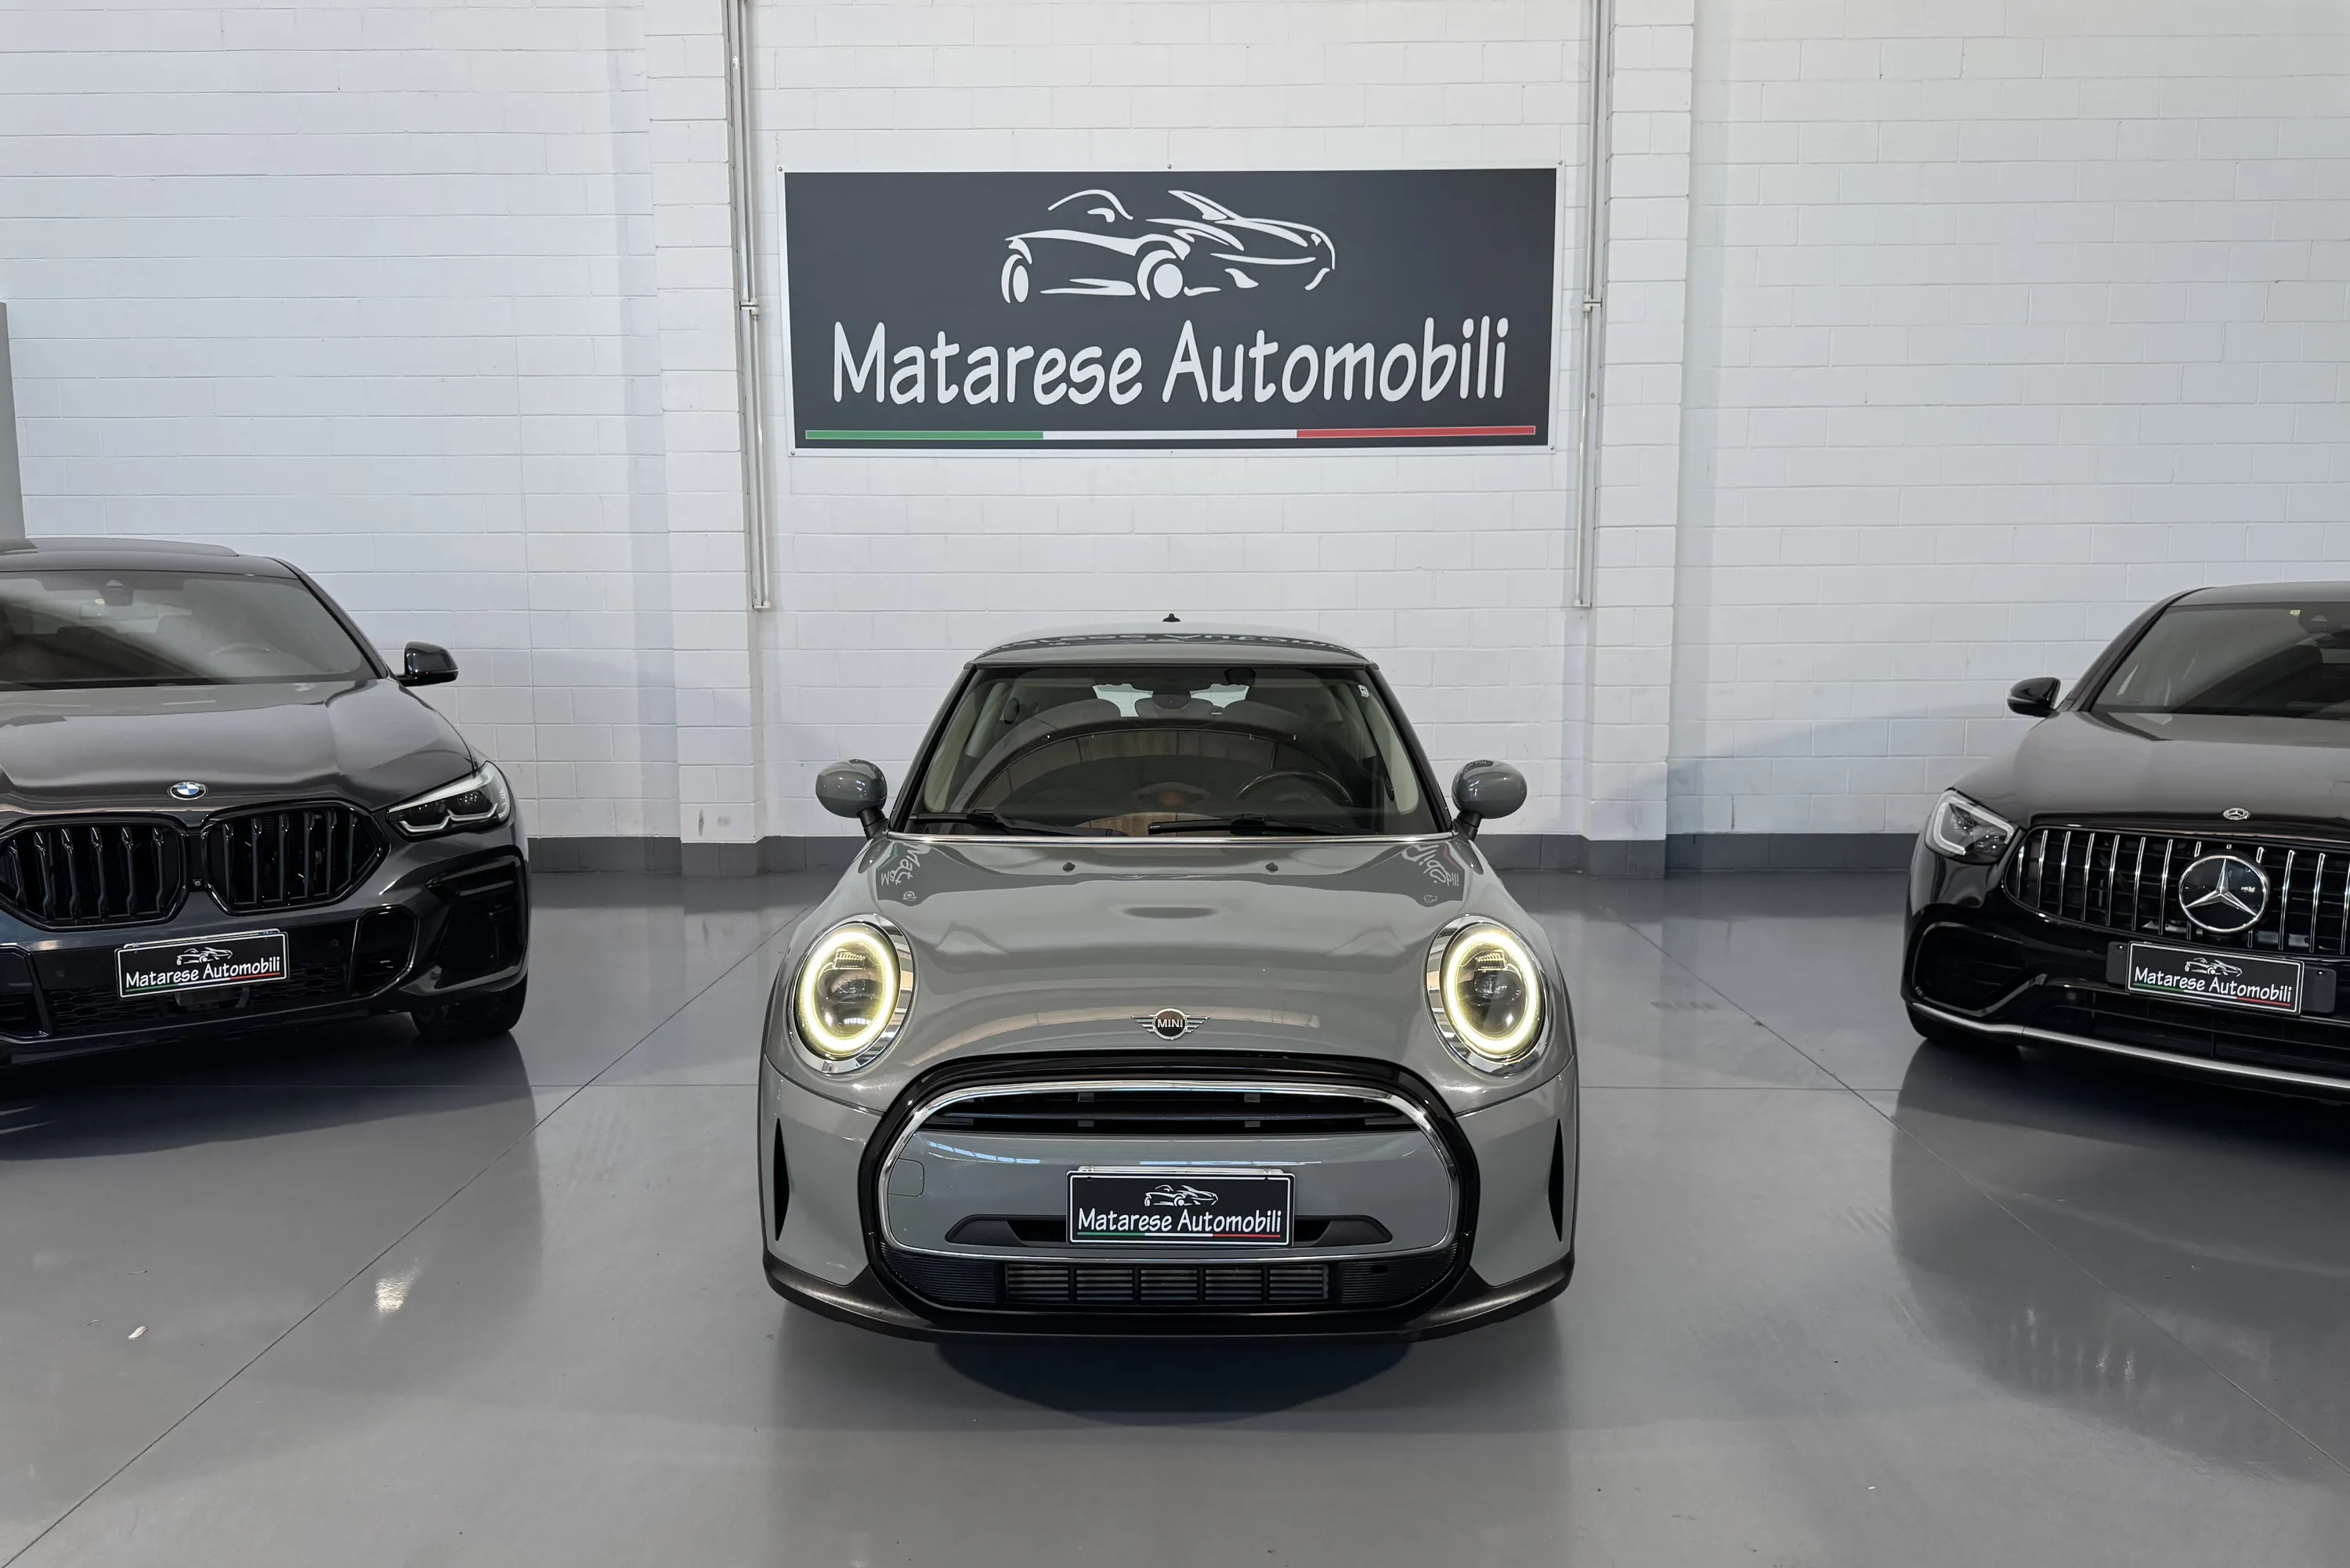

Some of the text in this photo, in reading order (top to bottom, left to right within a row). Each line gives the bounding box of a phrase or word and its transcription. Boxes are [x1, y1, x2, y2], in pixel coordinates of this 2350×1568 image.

[833, 315, 1509, 406] Matarese Automobili
[126, 956, 280, 988] Matarese Automobili
[2135, 966, 2292, 1003] Matarese Automobili
[1157, 1019, 1184, 1028] MINI
[1078, 1208, 1282, 1233] Matarese Automobili
